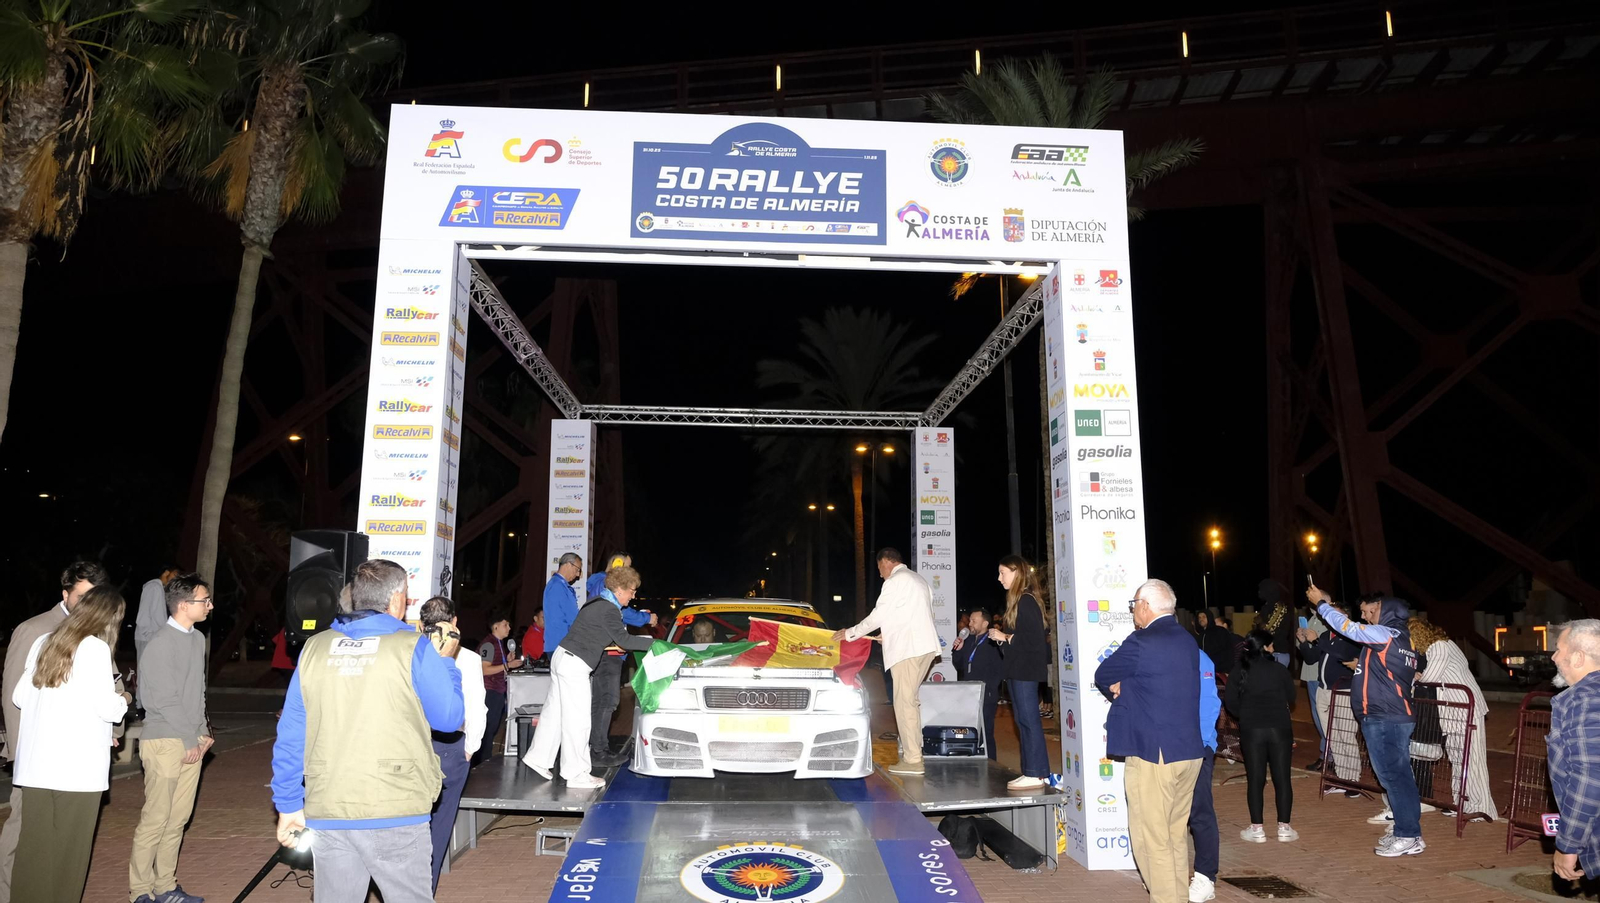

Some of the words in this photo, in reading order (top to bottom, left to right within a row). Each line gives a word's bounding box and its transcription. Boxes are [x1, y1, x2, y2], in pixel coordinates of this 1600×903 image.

[960, 147, 972, 160] CLUB
[656, 166, 705, 190] 50
[708, 168, 863, 195] RALLYE
[492, 192, 562, 205] CERA
[656, 194, 726, 209] COSTA
[730, 196, 759, 210] DE
[763, 197, 860, 213] ALMERÍA
[505, 213, 548, 224] Recalvi
[933, 215, 972, 225] COSTA
[974, 216, 988, 226] DE
[1031, 219, 1107, 232] DIPUTACIÓN
[921, 226, 990, 240] ALMERÍA
[1031, 231, 1048, 241] DE
[1051, 231, 1104, 243] ALMERÍA
[386, 308, 439, 320] Rallycar
[392, 334, 428, 343] Recalvi
[1074, 384, 1130, 398] MOYA
[379, 400, 432, 412] Rallycar
[385, 428, 421, 436] Recalvi
[1077, 445, 1132, 461] gasolia
[371, 495, 426, 507] Rallycar
[921, 496, 950, 504] MOYA
[1081, 505, 1135, 520] Phonika
[377, 523, 414, 532] Recalvi
[921, 529, 951, 538] gasolia
[922, 562, 951, 571] Phonika
[694, 846, 786, 869] AUTOMOVIL
[796, 851, 831, 868] CLUB
